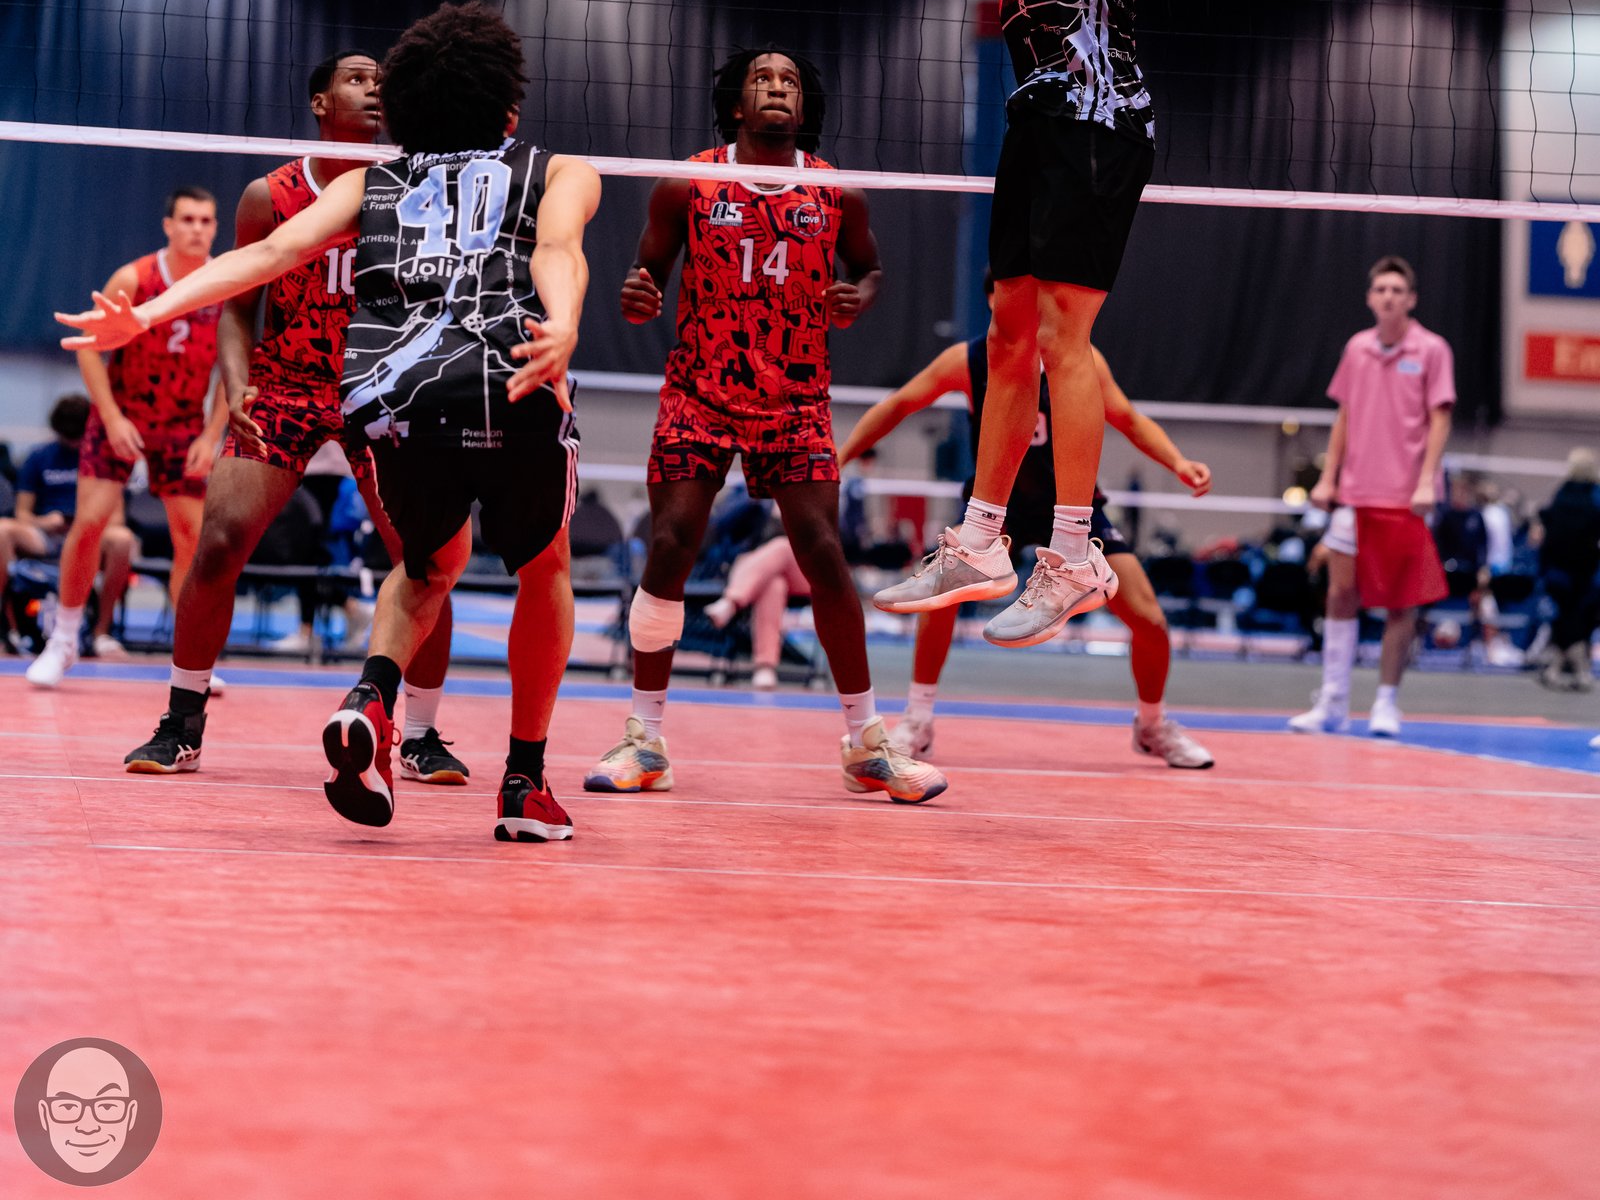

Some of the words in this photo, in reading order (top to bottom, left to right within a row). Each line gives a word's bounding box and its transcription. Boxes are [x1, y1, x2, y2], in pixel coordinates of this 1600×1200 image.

[396, 158, 513, 258] 40
[709, 201, 746, 221] A5
[401, 257, 476, 280] Joliet
[739, 237, 790, 286] 14
[166, 319, 191, 354] 2
[462, 428, 503, 438] Preson
